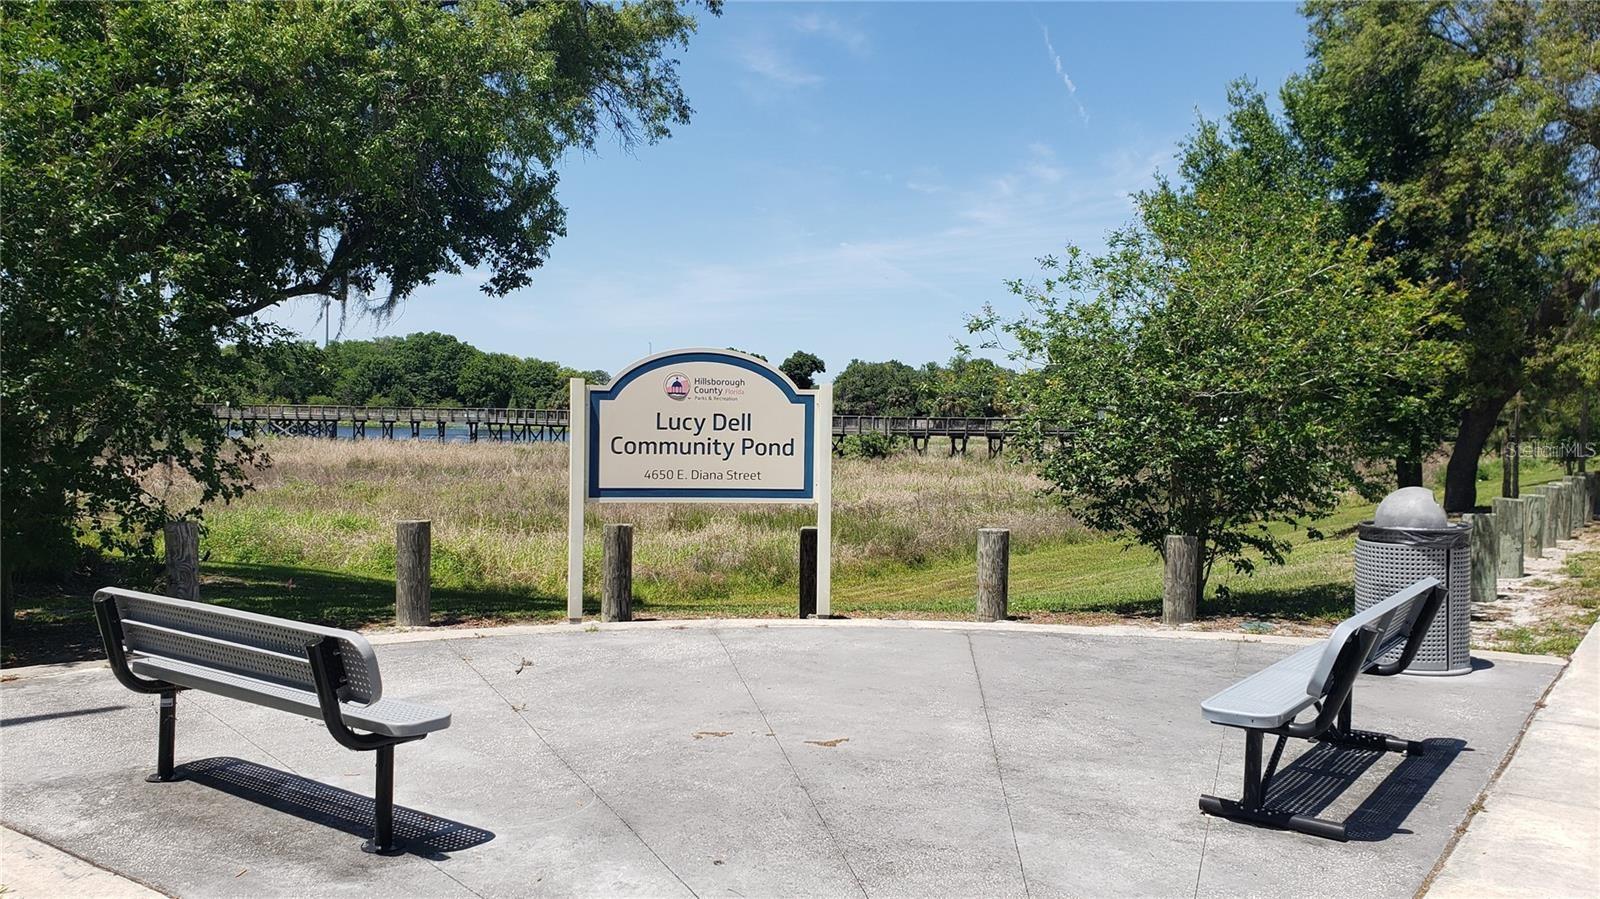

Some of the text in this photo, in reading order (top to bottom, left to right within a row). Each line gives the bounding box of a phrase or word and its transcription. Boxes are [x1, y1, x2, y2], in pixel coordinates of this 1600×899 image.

[694, 377, 746, 388] Hillsborough
[694, 386, 723, 396] County
[656, 412, 752, 436] Lucy Dell
[610, 436, 795, 461] Community Pond
[644, 469, 762, 481] 4650 E. Diana Street
